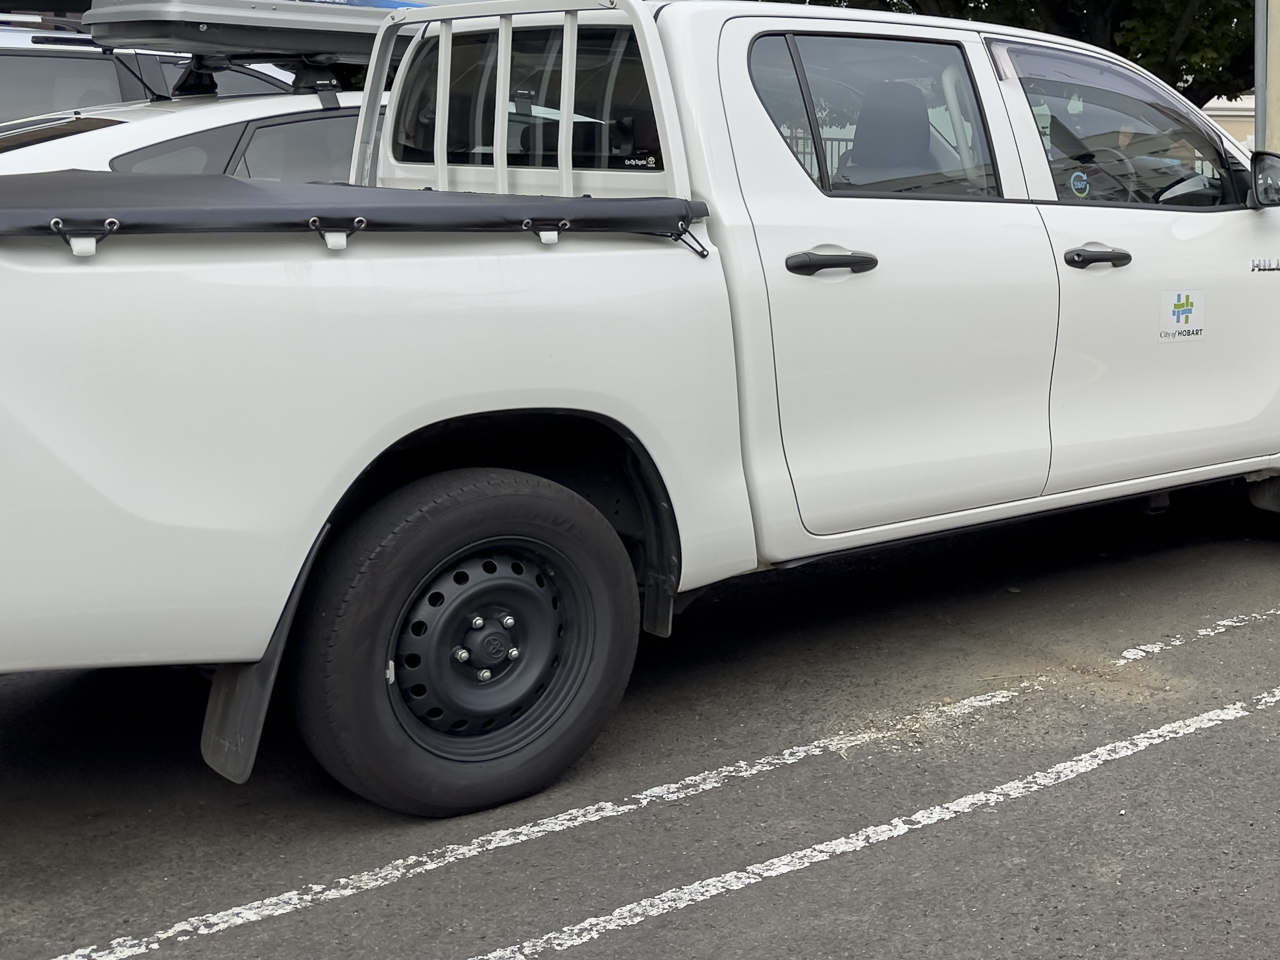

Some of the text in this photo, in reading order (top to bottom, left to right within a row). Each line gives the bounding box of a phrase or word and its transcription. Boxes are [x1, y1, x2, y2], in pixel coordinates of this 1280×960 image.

[1159, 329, 1203, 340] City of HOBART
